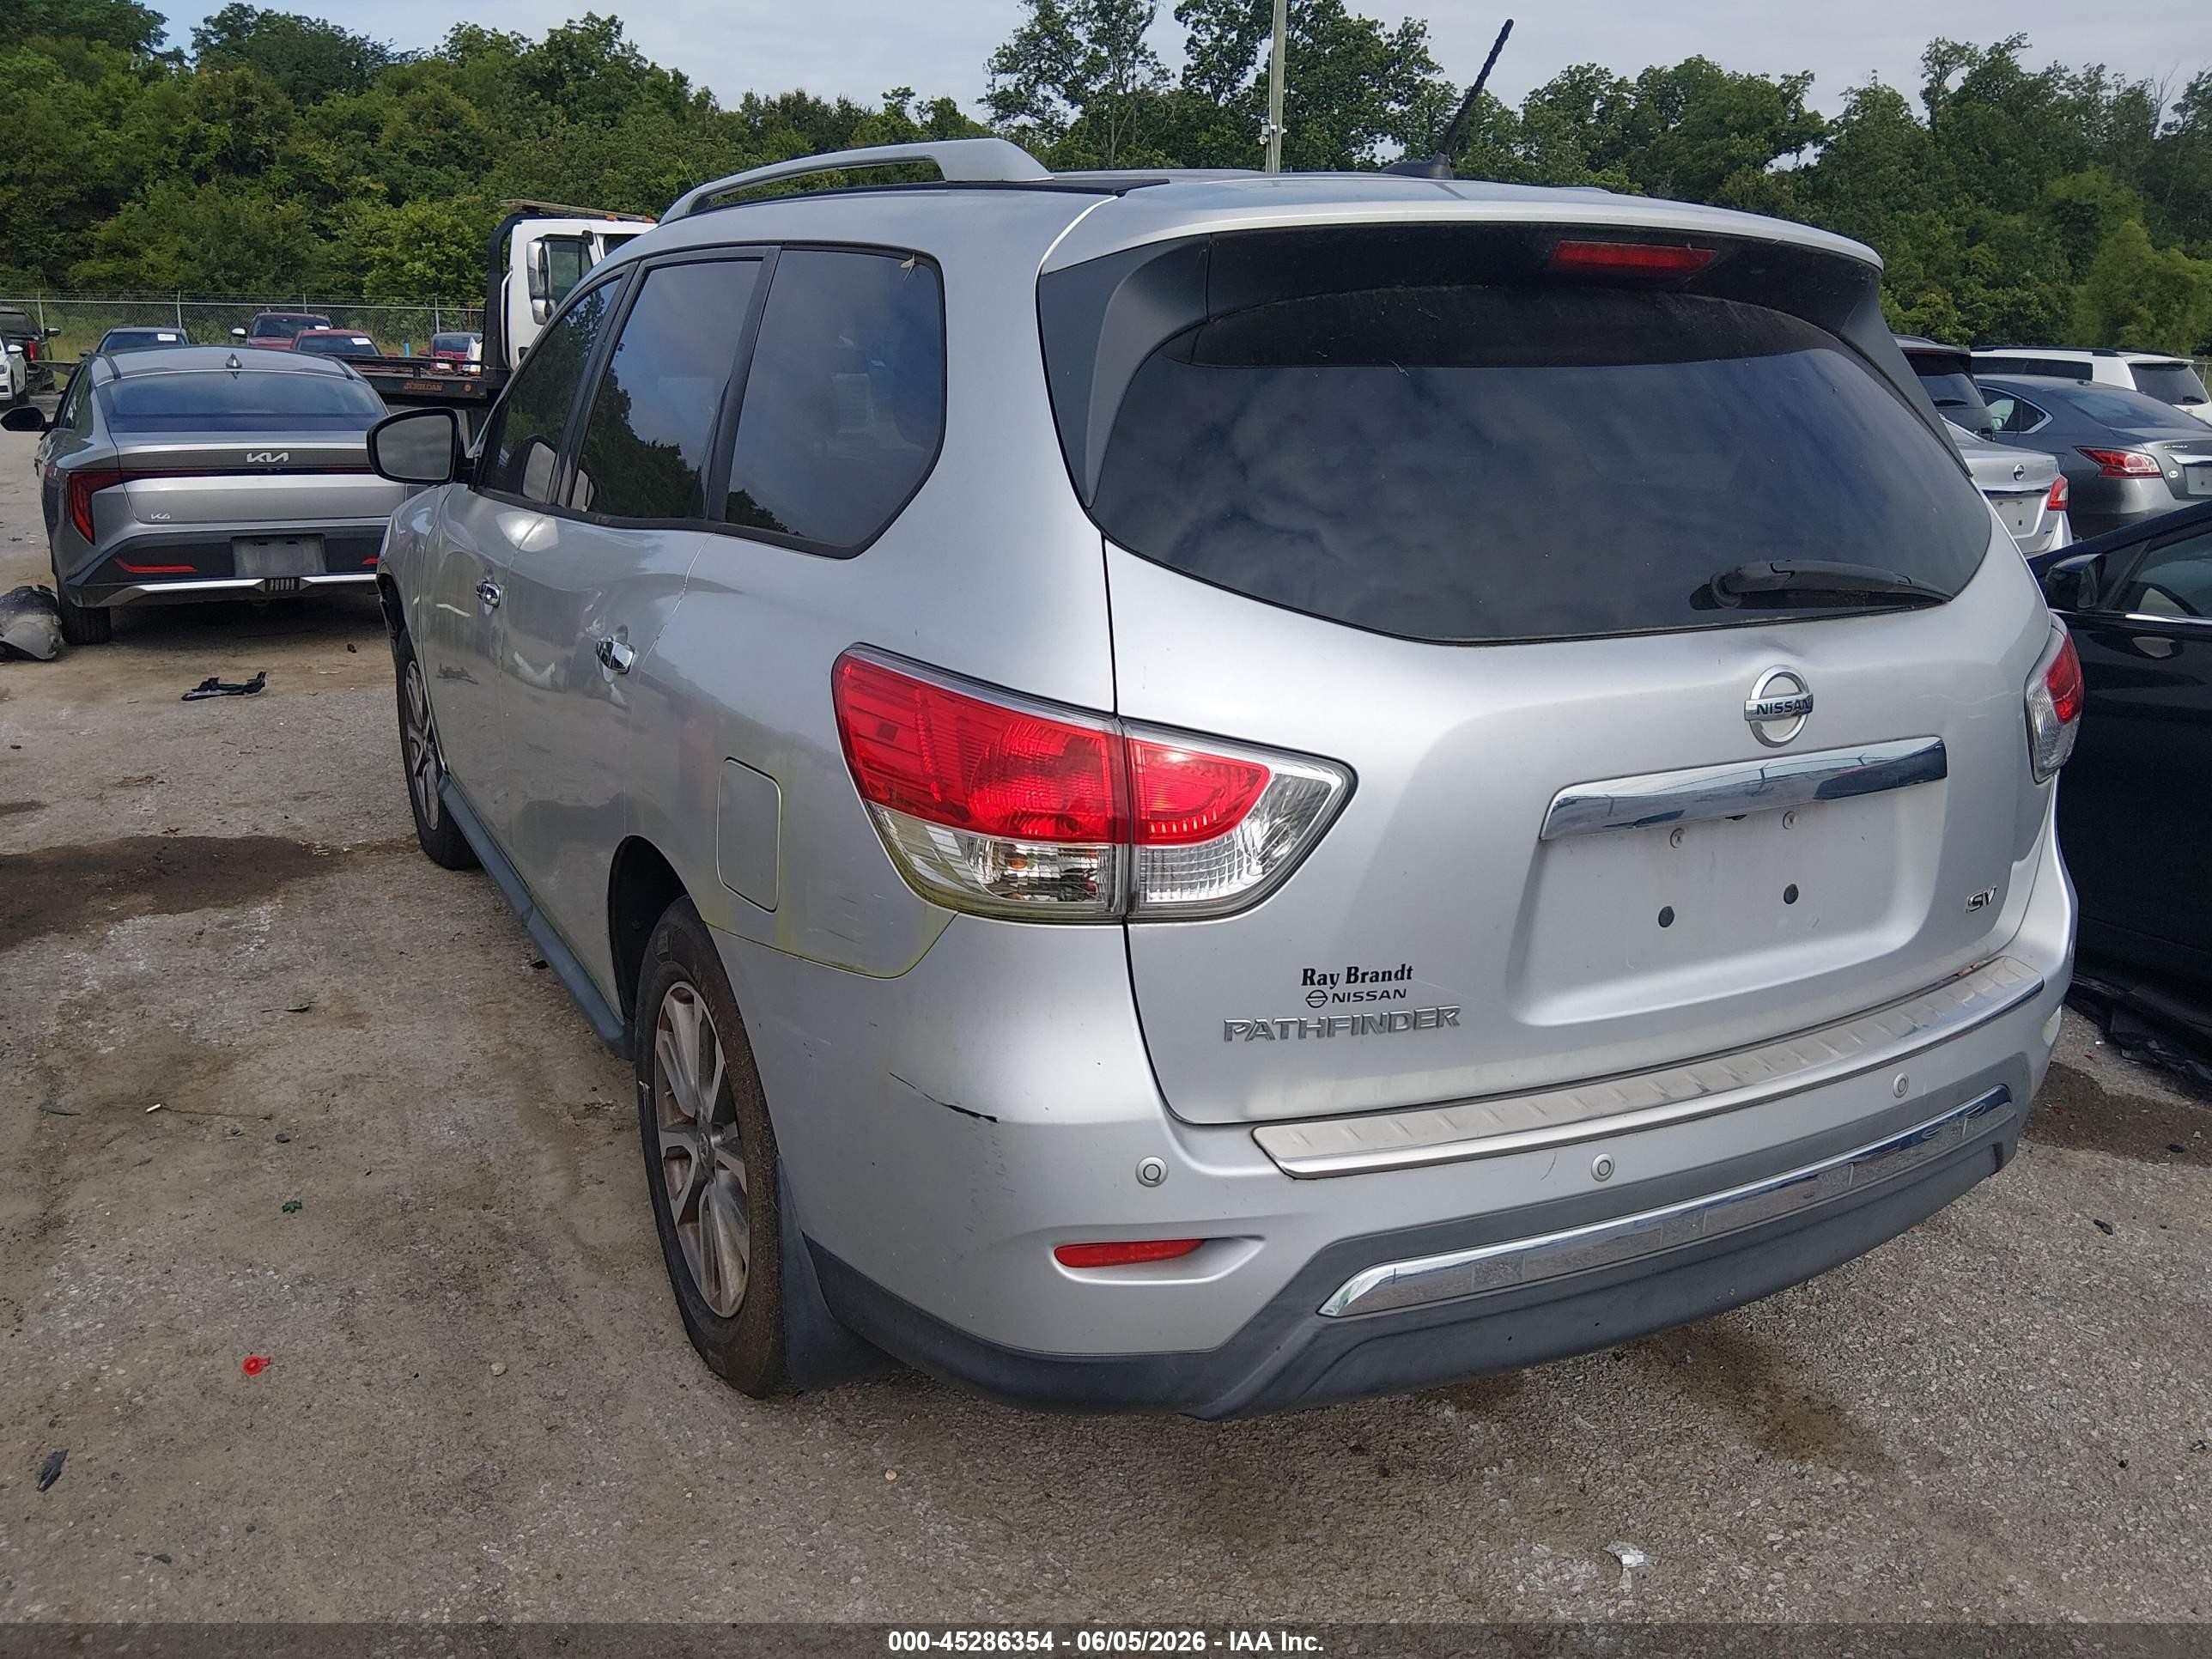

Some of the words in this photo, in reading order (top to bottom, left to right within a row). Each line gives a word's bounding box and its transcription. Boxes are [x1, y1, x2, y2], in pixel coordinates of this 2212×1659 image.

[246, 452, 289, 463] KIA
[1756, 698, 1812, 715] NISSAN
[1966, 885, 1997, 913] SV
[1301, 968, 1340, 989] Ray
[1346, 963, 1413, 984] Brandt
[1332, 988, 1407, 1004] NISSAN
[1224, 1005, 1461, 1042] PATHFINDER
